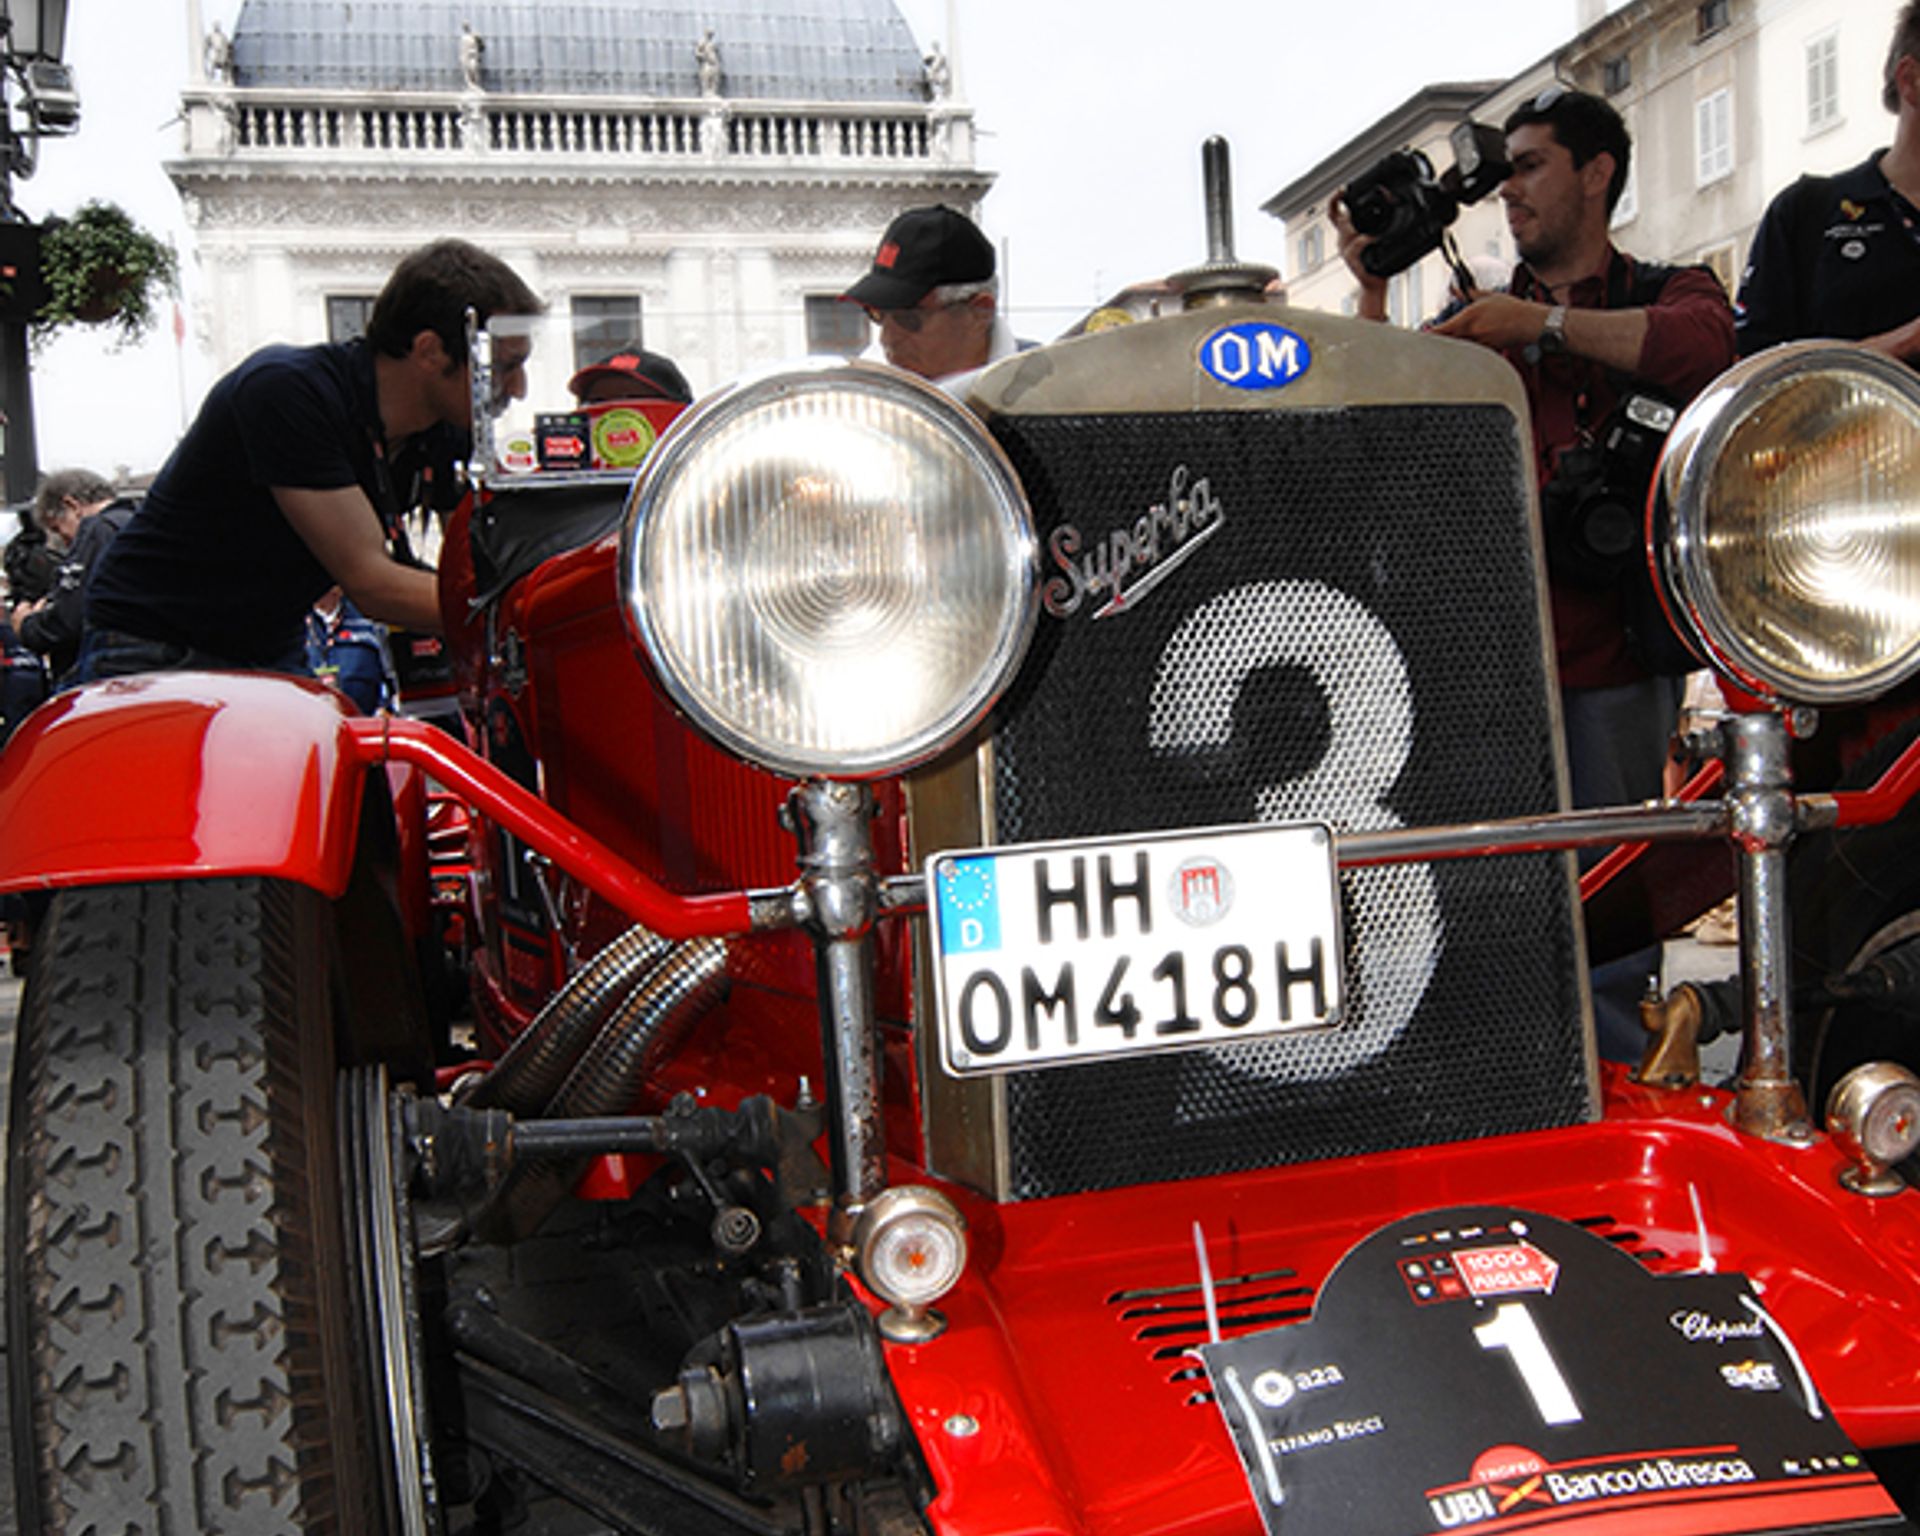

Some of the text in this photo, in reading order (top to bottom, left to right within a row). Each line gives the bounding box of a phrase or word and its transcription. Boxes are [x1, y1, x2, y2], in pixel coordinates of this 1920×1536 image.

[1210, 330, 1301, 380] OM
[1043, 464, 1226, 618] Superba
[1033, 850, 1152, 945] HH
[961, 918, 984, 948] D
[1467, 1251, 1529, 1271] 1000
[1472, 1302, 1583, 1425] 1
[1429, 1487, 1497, 1528] UBI
